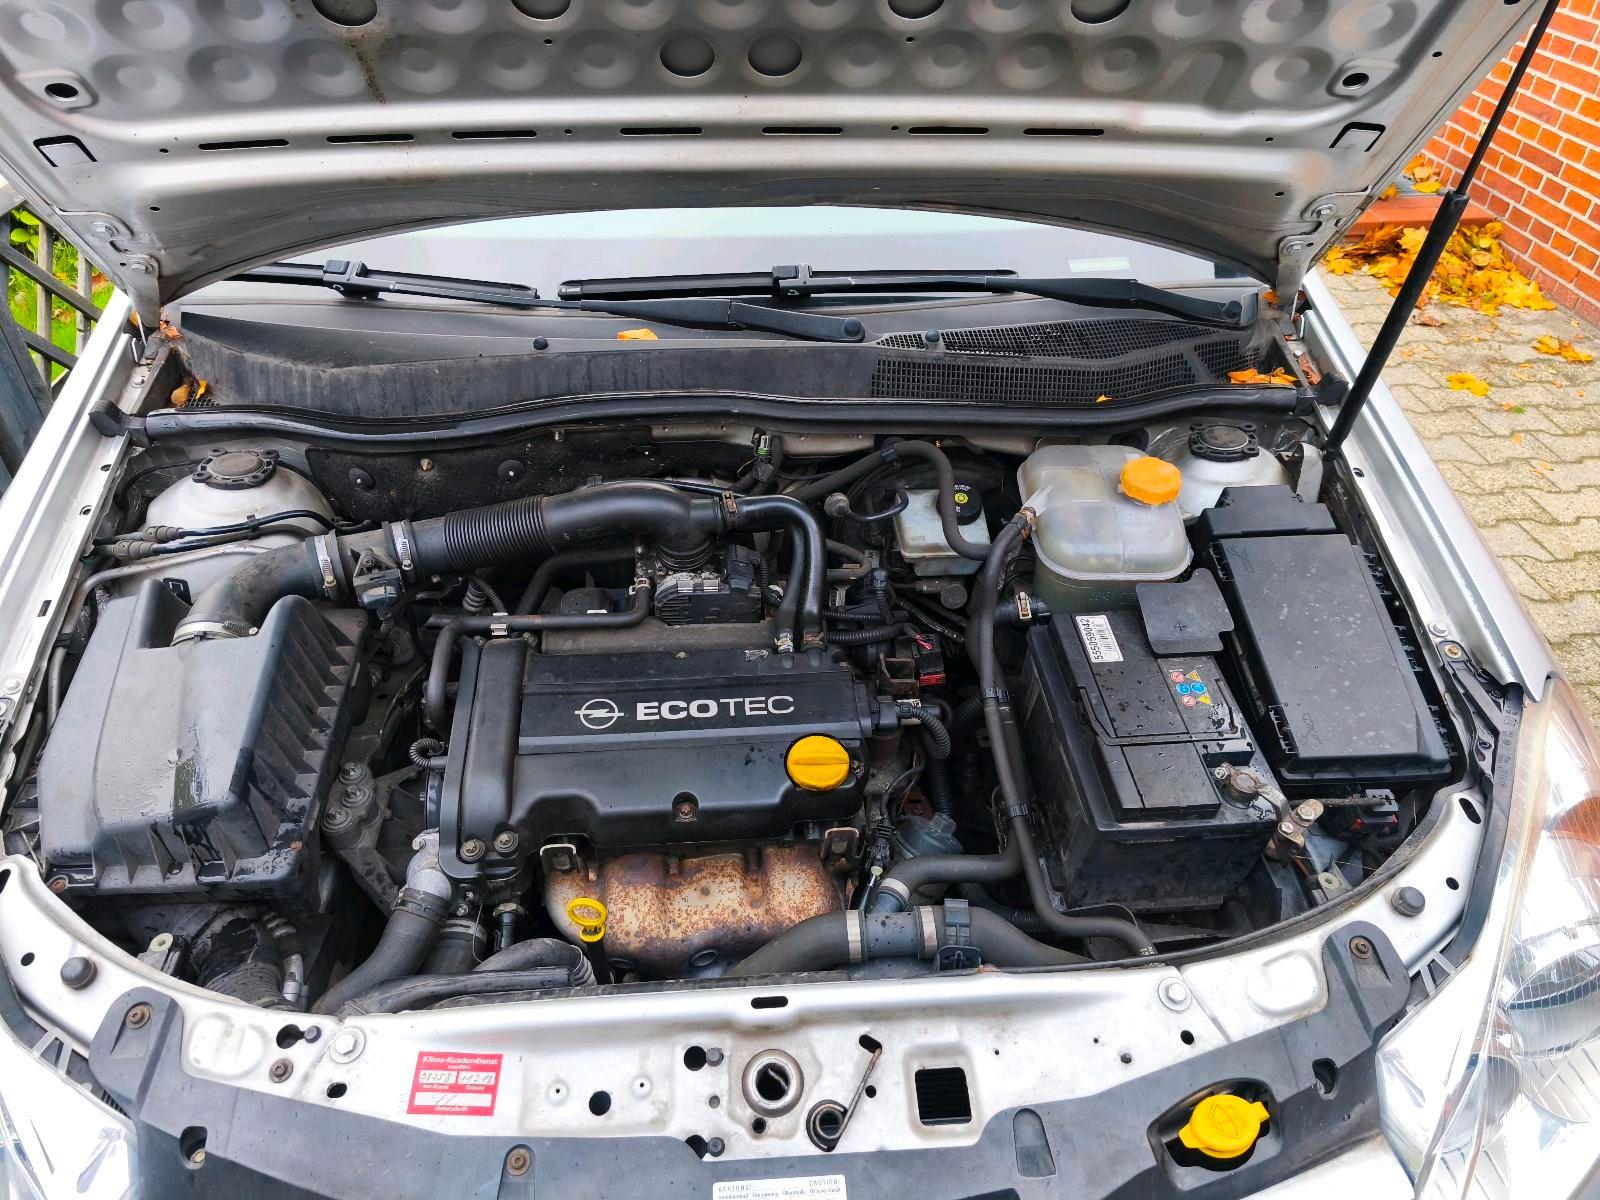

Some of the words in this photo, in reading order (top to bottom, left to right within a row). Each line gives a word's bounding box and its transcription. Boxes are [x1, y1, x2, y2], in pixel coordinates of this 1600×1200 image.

[1080, 618, 1104, 660] 555059042
[636, 695, 795, 721] ECOTEC
[422, 1056, 498, 1065] Klima-Kundendienst
